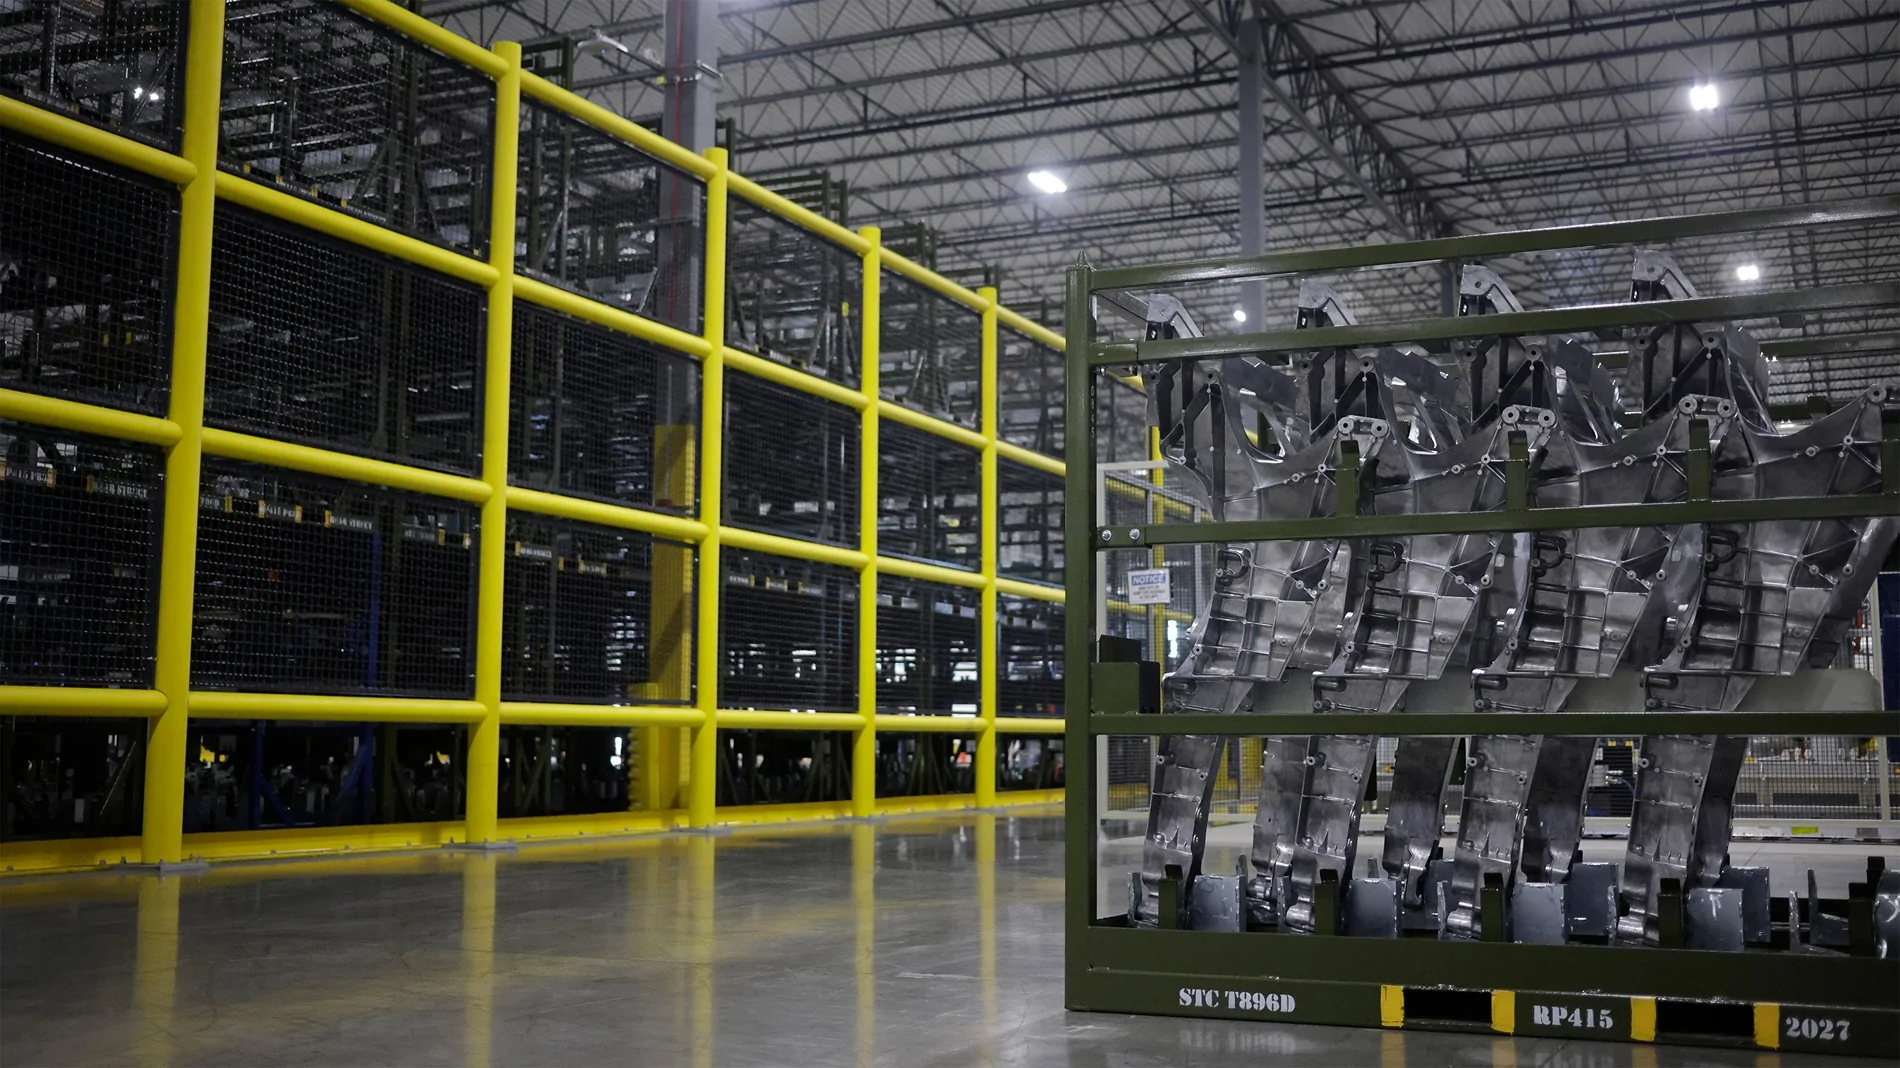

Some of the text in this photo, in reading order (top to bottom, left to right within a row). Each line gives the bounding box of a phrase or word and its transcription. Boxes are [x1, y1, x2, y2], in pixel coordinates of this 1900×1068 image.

[1132, 574, 1164, 585] NOTICE
[1179, 988, 1296, 1013] STC T896D
[1533, 1005, 1613, 1030] RP415
[1786, 1017, 1850, 1041] 2027
